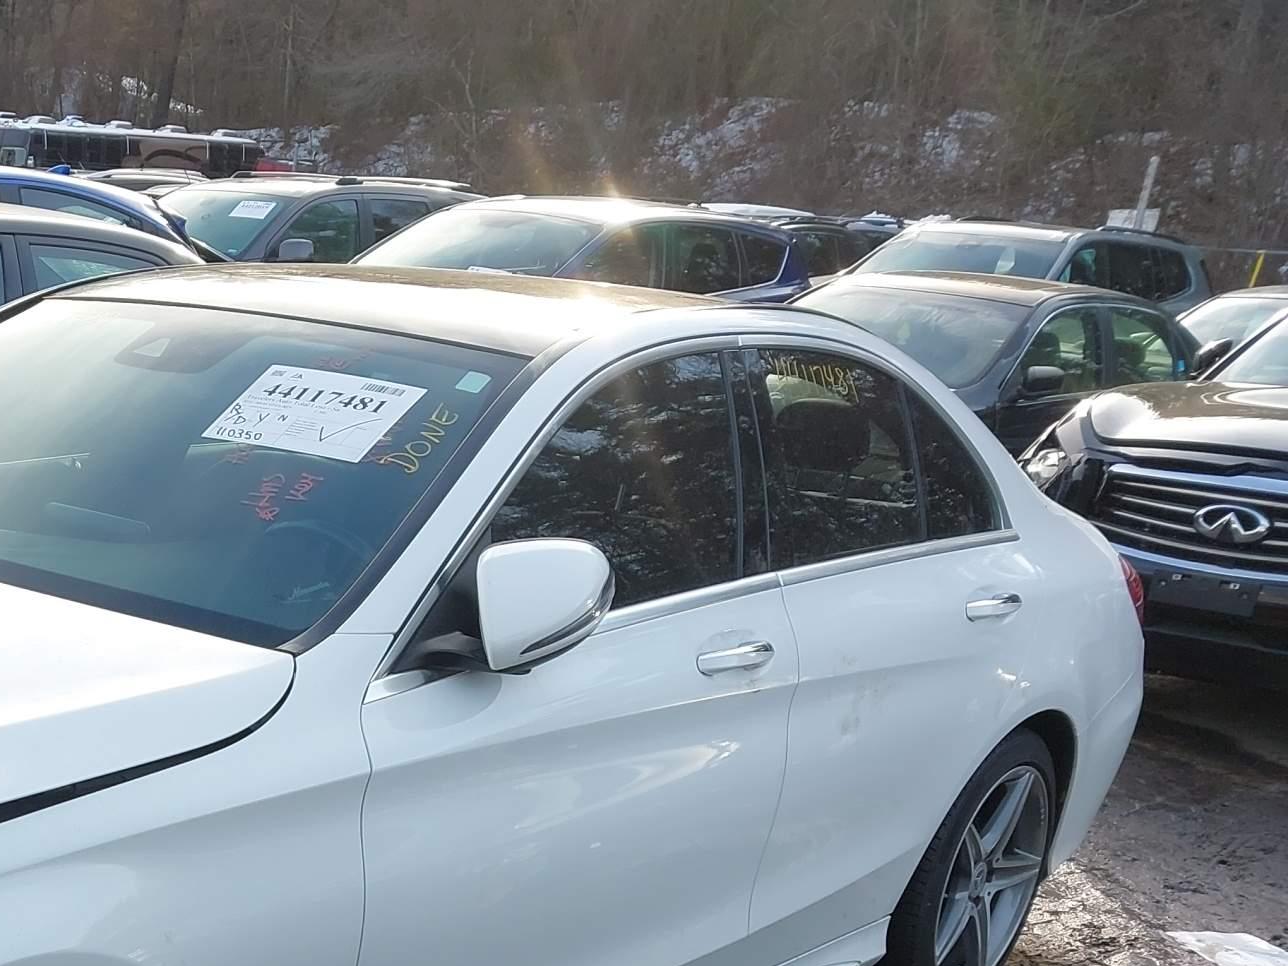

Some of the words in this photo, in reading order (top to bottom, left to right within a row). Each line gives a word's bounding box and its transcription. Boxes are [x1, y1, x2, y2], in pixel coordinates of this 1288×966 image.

[263, 384, 388, 413] 44117481
[216, 426, 263, 441] 110350
[380, 402, 460, 473] DONE
